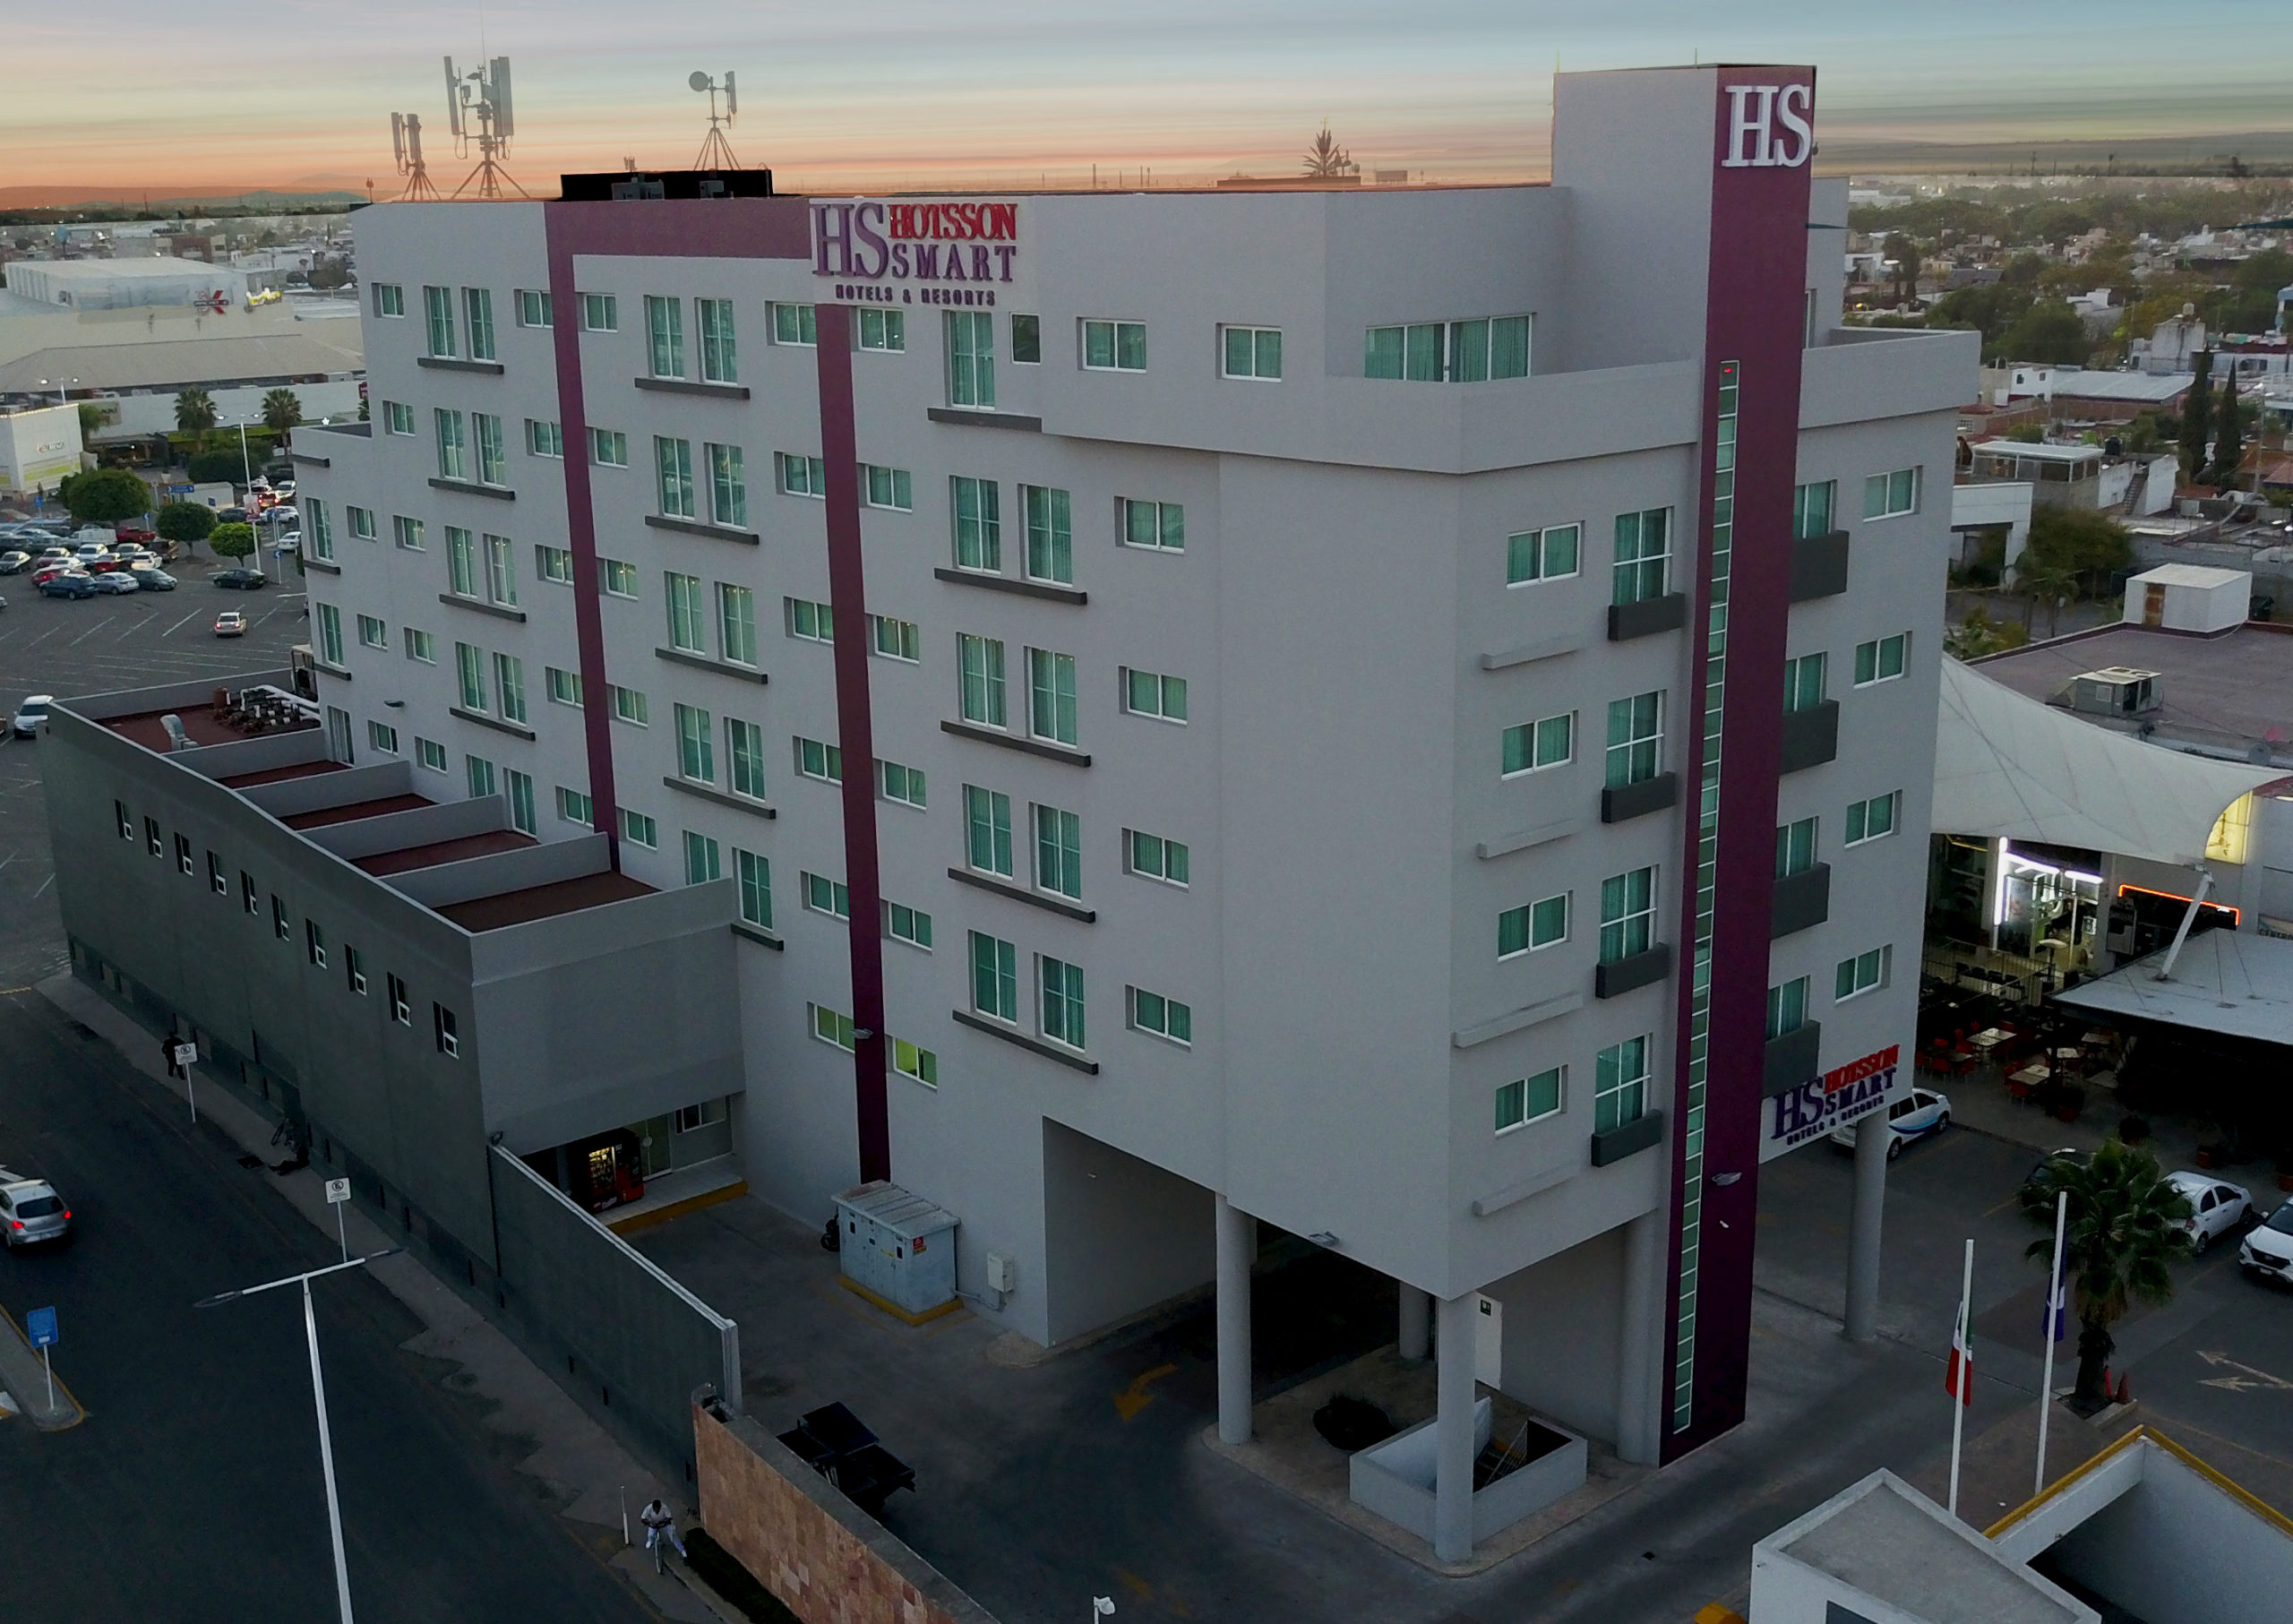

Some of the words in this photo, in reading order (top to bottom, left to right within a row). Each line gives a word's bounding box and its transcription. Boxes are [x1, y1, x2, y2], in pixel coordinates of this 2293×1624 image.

[1721, 84, 1811, 168] HS
[810, 202, 889, 279] HS
[887, 203, 1018, 241] HOTSSON
[892, 243, 1017, 282] SMART
[836, 284, 893, 302] HOTELS
[902, 288, 912, 304] &
[921, 288, 996, 306] RESORTS
[1771, 1076, 1824, 1139] HS
[1825, 1067, 1897, 1115] SMART
[1787, 1121, 1825, 1146] HOTELS
